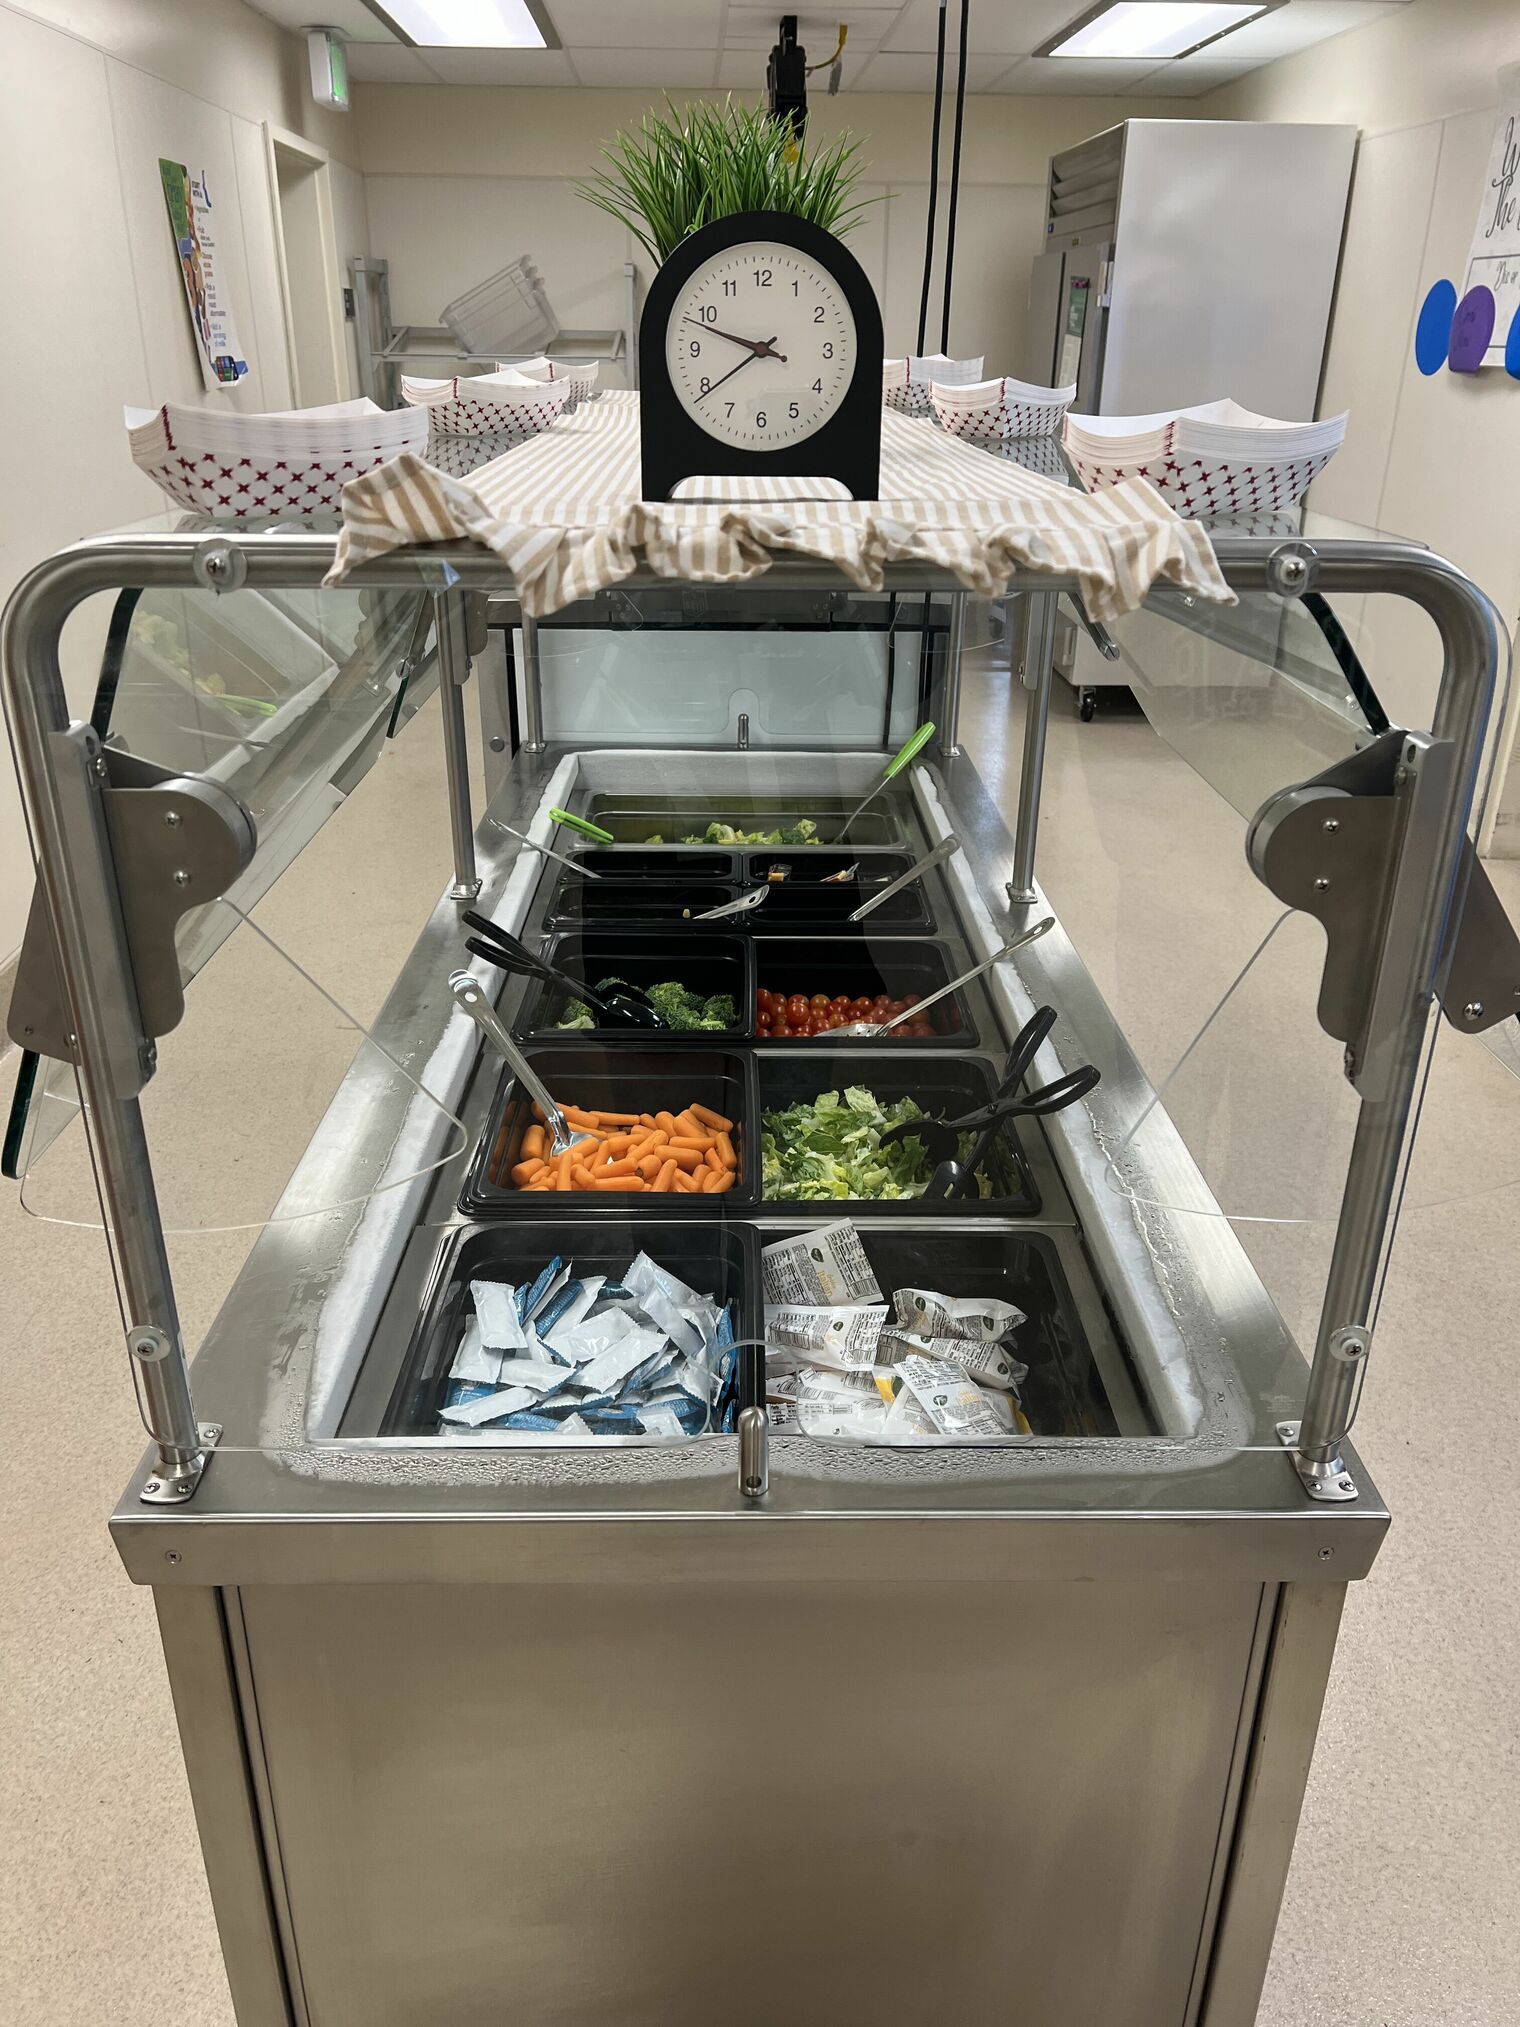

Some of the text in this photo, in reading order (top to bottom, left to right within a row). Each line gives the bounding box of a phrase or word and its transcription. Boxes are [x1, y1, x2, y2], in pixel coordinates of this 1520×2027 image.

[1485, 174, 1516, 238] The
[753, 269, 773, 287] 12
[721, 280, 737, 297] 11
[791, 280, 799, 297] 1
[698, 305, 717, 322] 10
[813, 306, 825, 323] 2
[690, 341, 701, 358] 9
[822, 342, 833, 359] 3
[700, 377, 711, 393] 8
[811, 378, 823, 394] 4
[724, 402, 735, 418] 7
[788, 402, 800, 419] 5
[756, 411, 767, 428] 6
